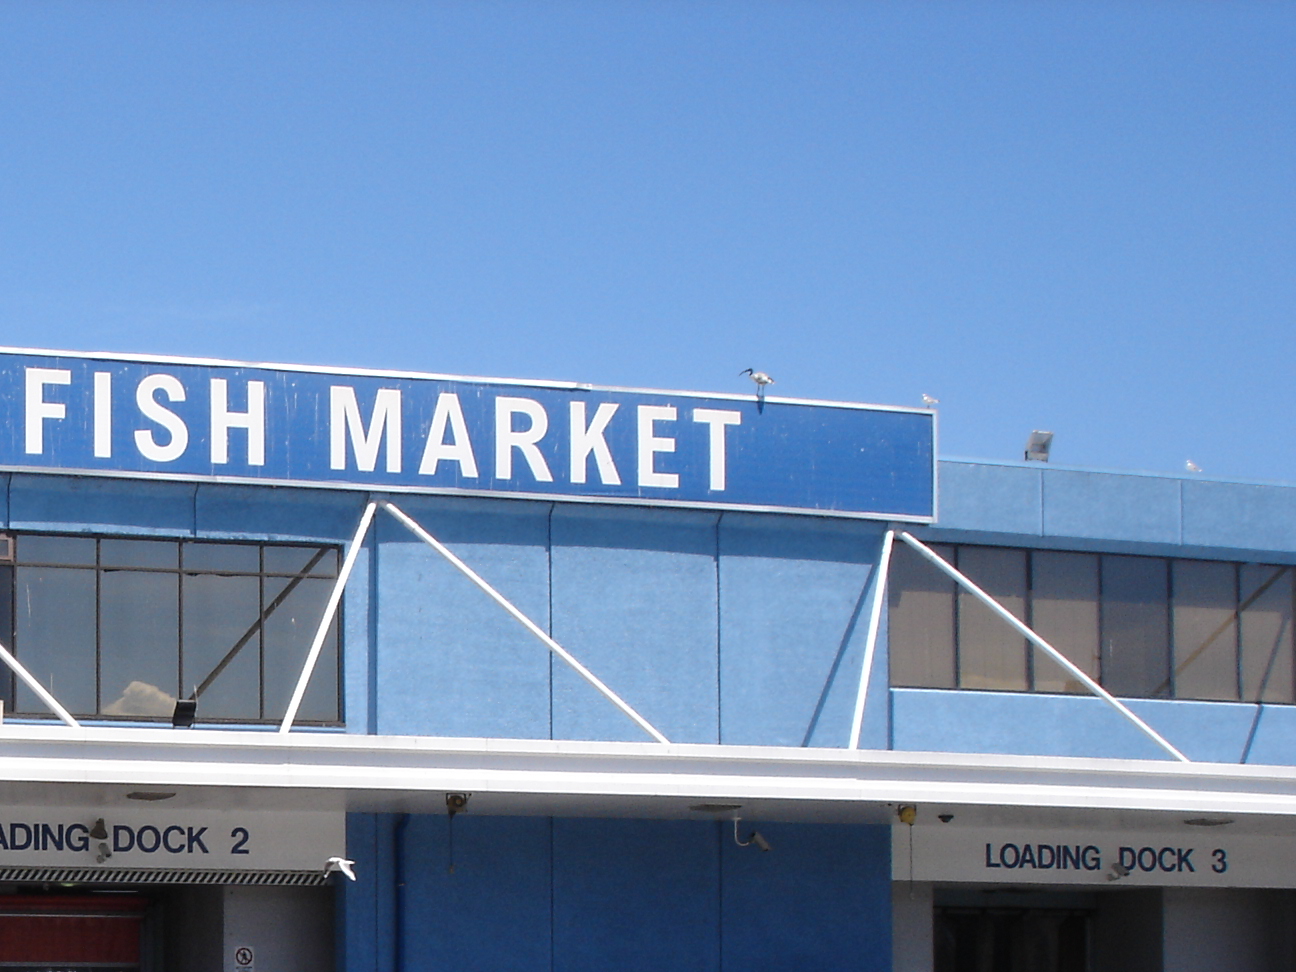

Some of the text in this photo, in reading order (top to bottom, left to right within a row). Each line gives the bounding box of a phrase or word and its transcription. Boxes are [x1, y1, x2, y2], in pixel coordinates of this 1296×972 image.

[25, 367, 267, 466] FISH
[329, 385, 742, 492] MARKET
[113, 824, 209, 854] DOCK
[230, 826, 250, 855] 2
[985, 842, 1229, 874] LOADING DOCK 3
